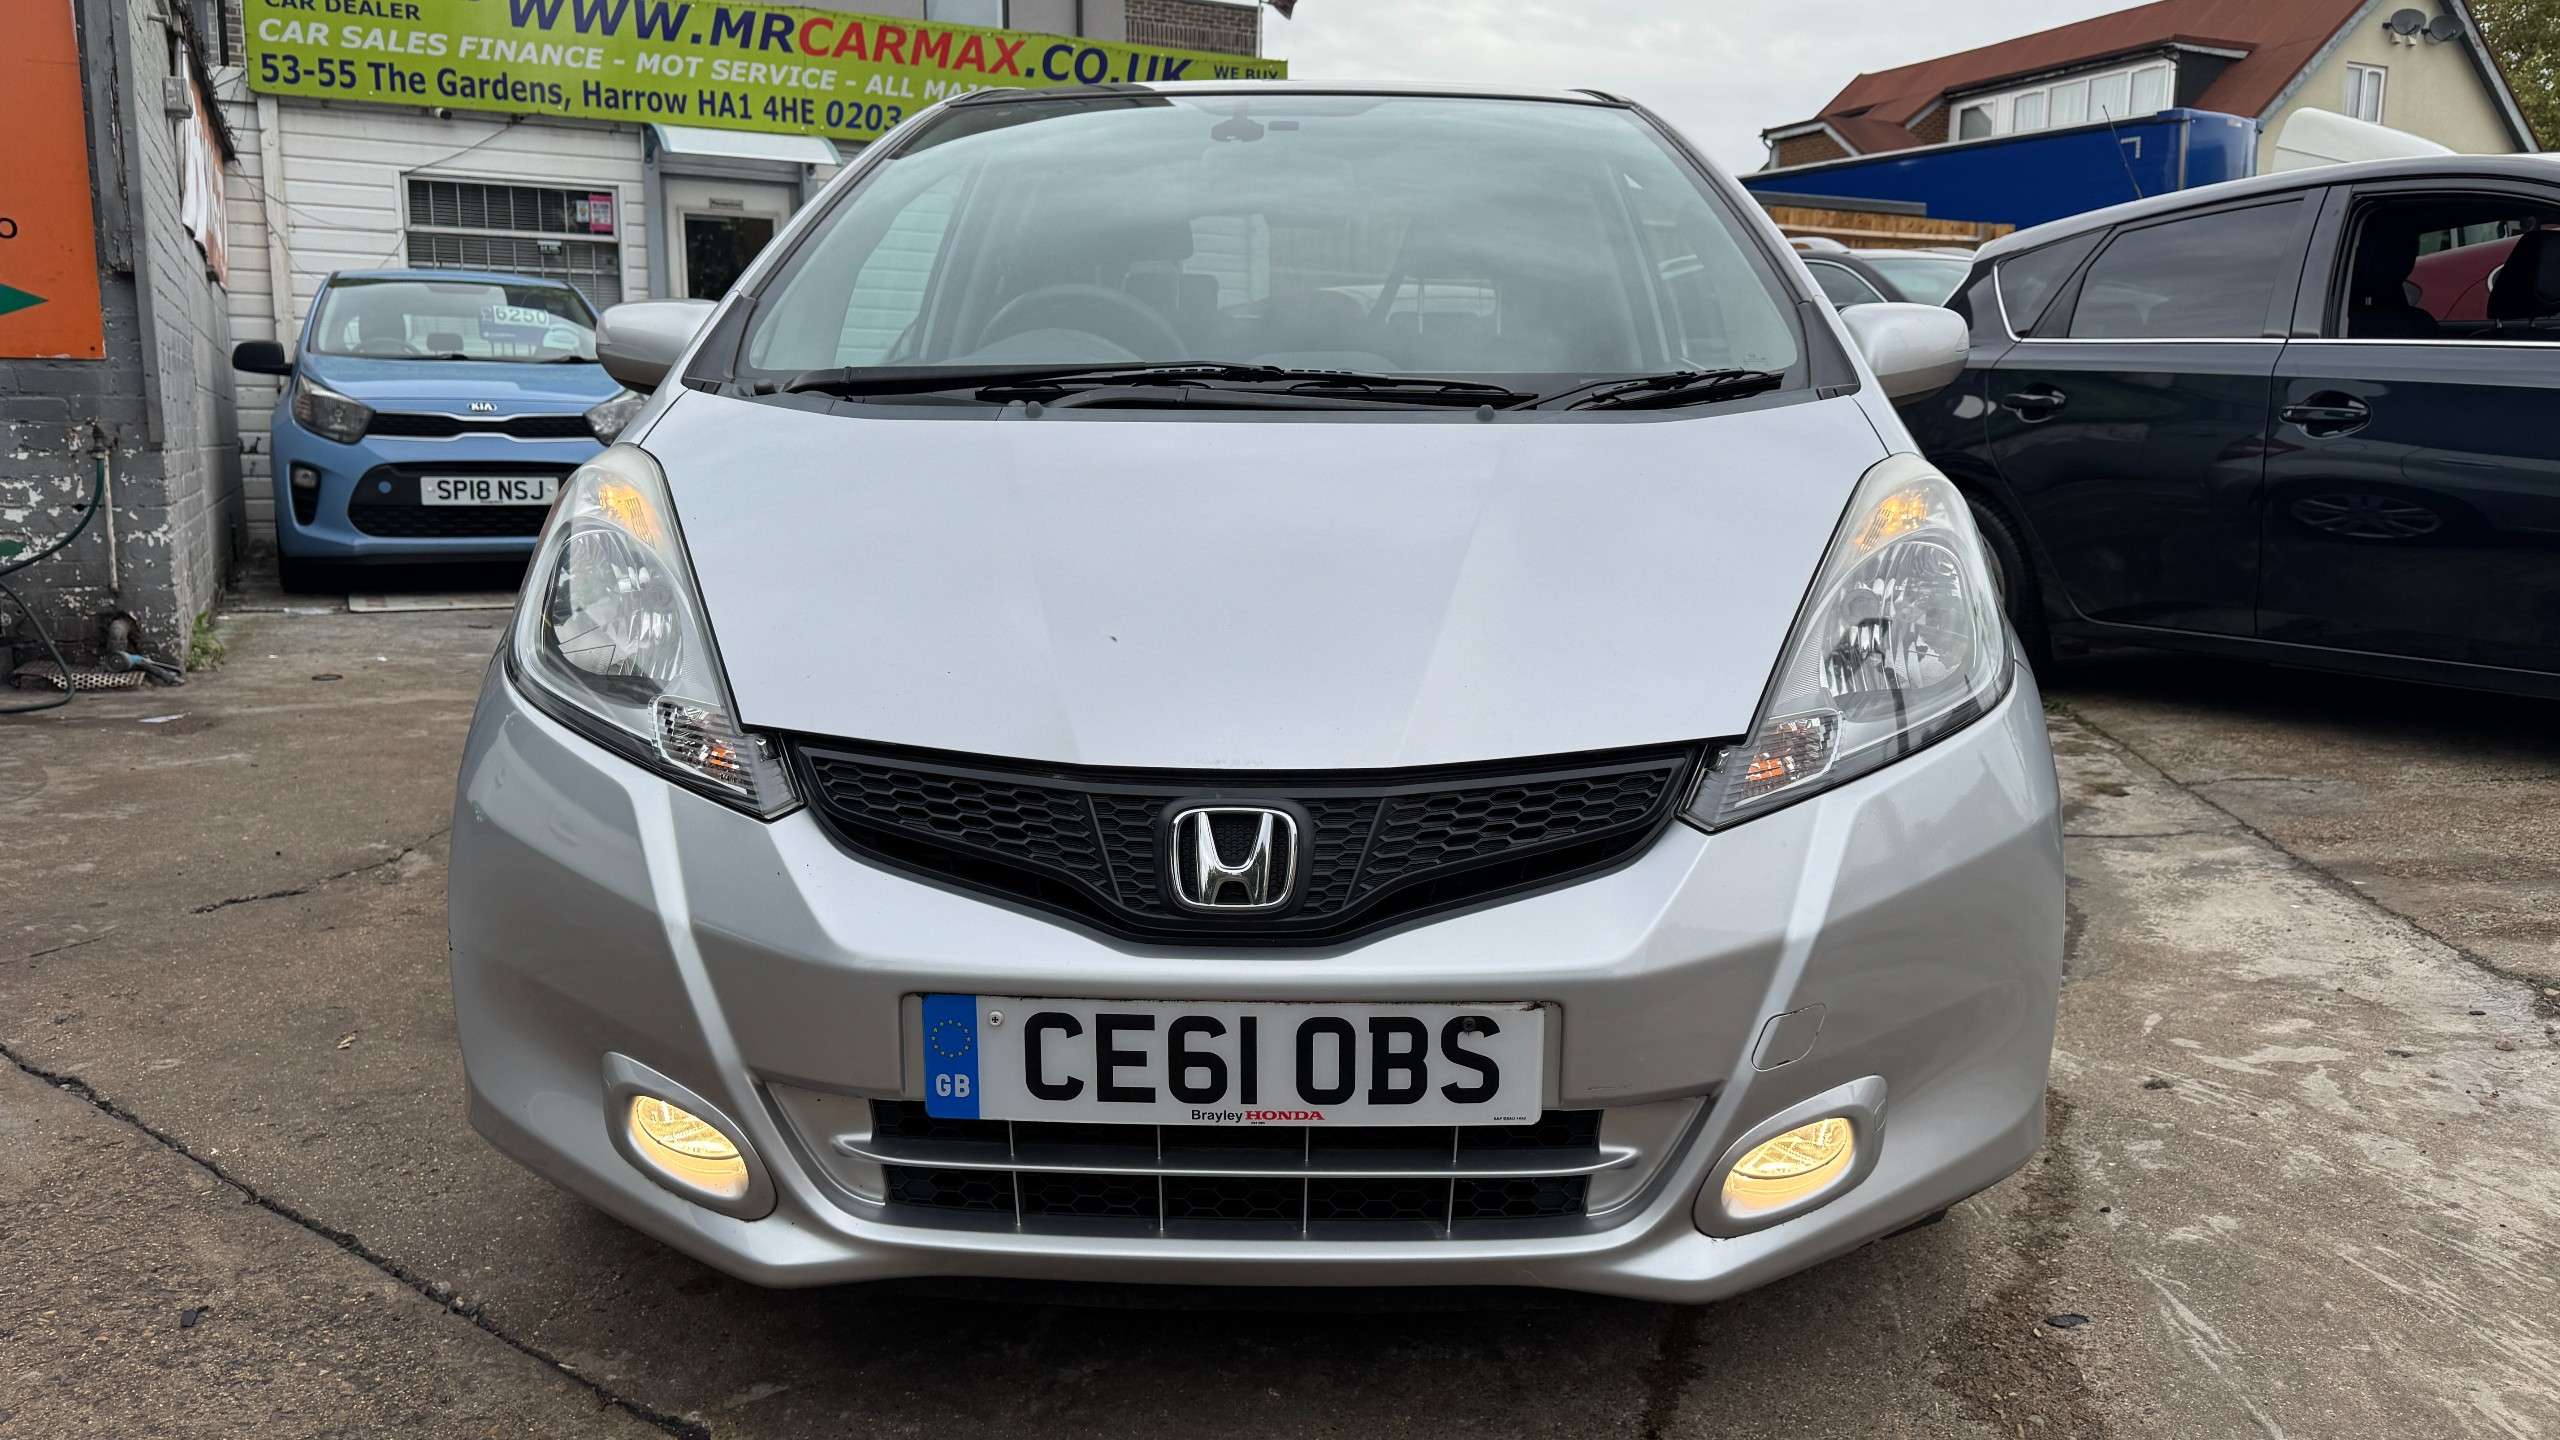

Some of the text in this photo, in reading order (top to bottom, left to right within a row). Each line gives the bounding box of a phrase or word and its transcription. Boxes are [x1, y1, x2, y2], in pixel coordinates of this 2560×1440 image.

[325, 0, 421, 20] DEALER
[508, 0, 1195, 84] WWW.MRCARMAX.CO.UK
[259, 18, 329, 46] CAR
[341, 25, 448, 56] SALES
[458, 36, 604, 69] FINANCE
[636, 52, 703, 78] MOT
[711, 59, 837, 91] SERVICE
[865, 74, 914, 99] ALL
[1214, 65, 1278, 79] WE BUY
[261, 53, 902, 132] 53-55 The Gardens, Harrow HA1 4HE 0203
[470, 402, 494, 412] KIA
[437, 480, 544, 500] SP18 NSJ
[1023, 1012, 1502, 1105] CE61 OBS
[935, 1073, 970, 1098] GB
[1191, 1109, 1326, 1123] Brayley HONDA
